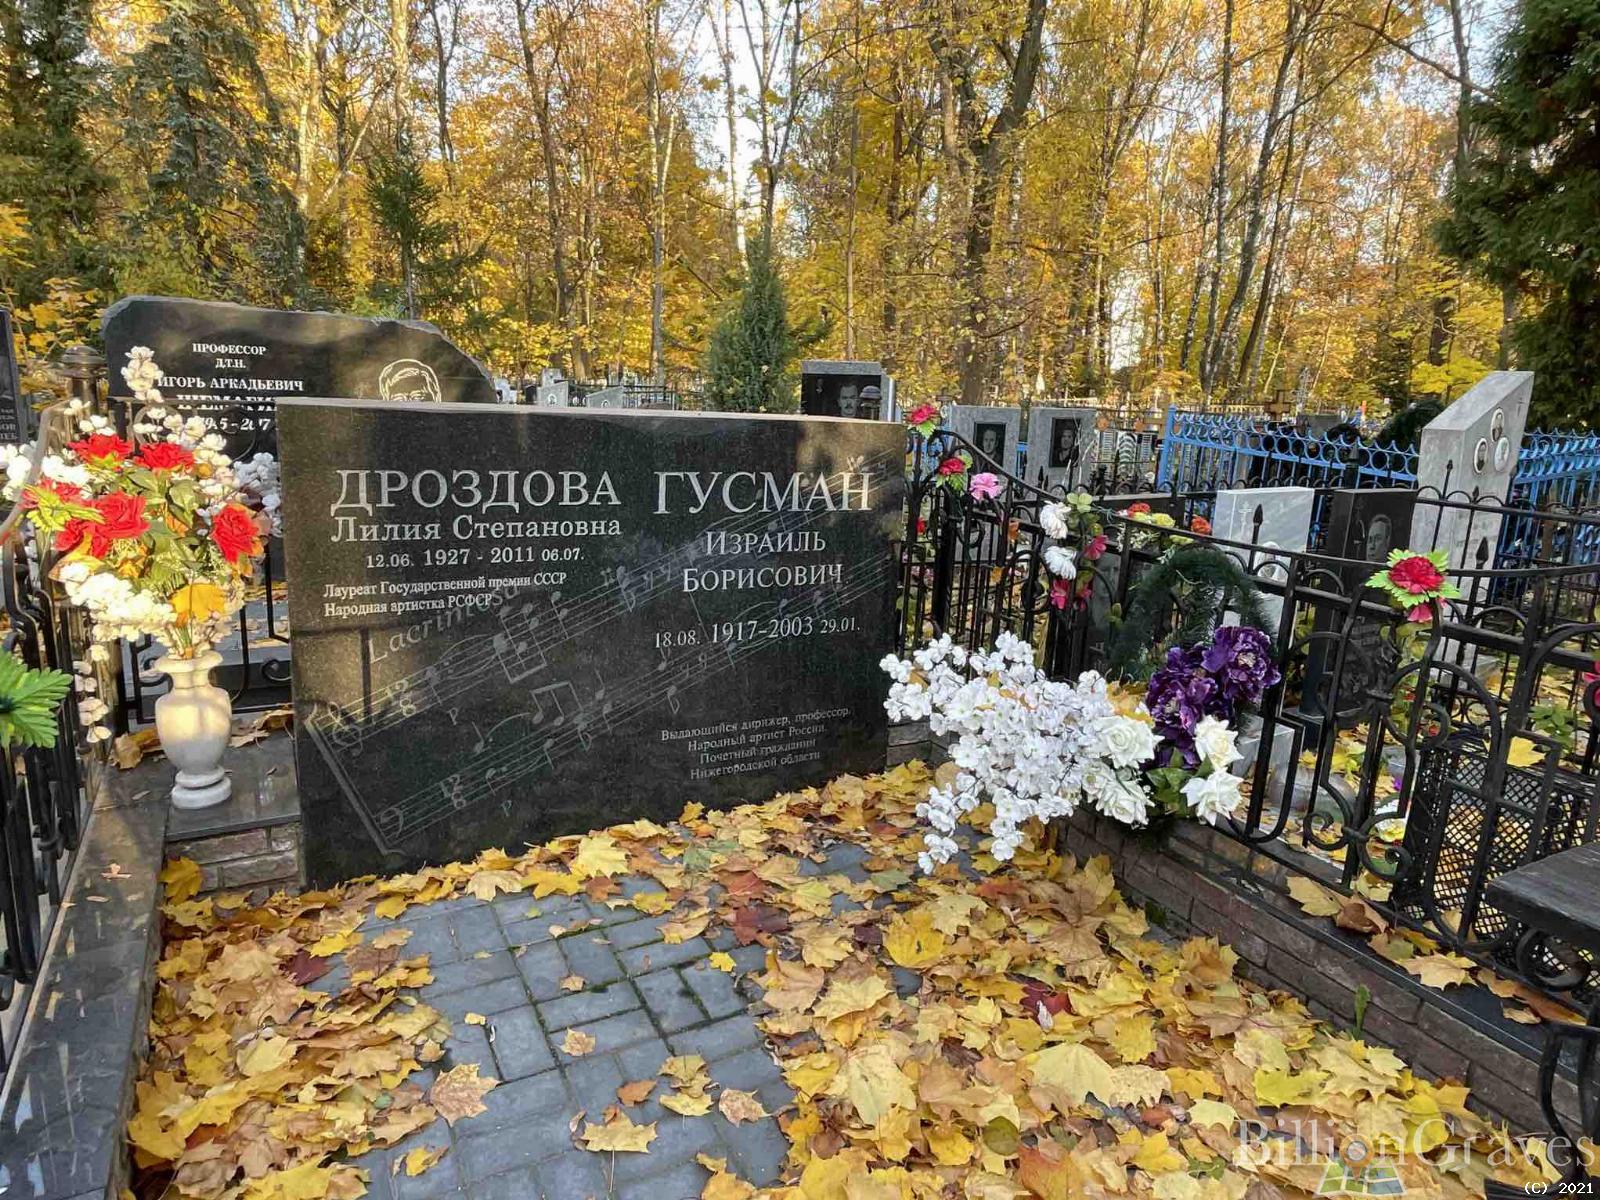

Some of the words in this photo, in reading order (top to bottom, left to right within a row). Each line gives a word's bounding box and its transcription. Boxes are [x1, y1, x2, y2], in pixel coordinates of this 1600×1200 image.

[192, 343, 267, 355] ПРОФЕССОР
[158, 377, 206, 388] ИГОРЬ
[210, 380, 304, 391] АРКАДЬЕВИЧ
[330, 469, 622, 517] ДРОЗДОВА
[653, 471, 875, 514] ГУСМАН
[330, 516, 441, 543] Лилия
[452, 514, 622, 540] Степановна
[366, 552, 415, 569] 12.06.
[423, 548, 471, 567] 1927
[489, 547, 535, 564] 2011
[541, 547, 585, 563] 06.07.
[322, 583, 377, 600] Лауреат
[380, 576, 486, 597] Государственной
[488, 576, 531, 589] премии
[533, 571, 567, 585] СССР
[323, 602, 388, 619] Народная
[390, 598, 446, 614] артистка
[447, 593, 493, 609] РСФСР
[655, 630, 701, 648] 18.08.
[712, 616, 813, 643] 1917-2003
[820, 617, 861, 634] 29.01.
[661, 722, 739, 741] Выдающийся
[688, 735, 746, 752] Народный
[749, 731, 785, 744] артист
[690, 759, 777, 780] Нижегородской
[780, 751, 821, 766] области
[700, 747, 757, 764] Почетный
